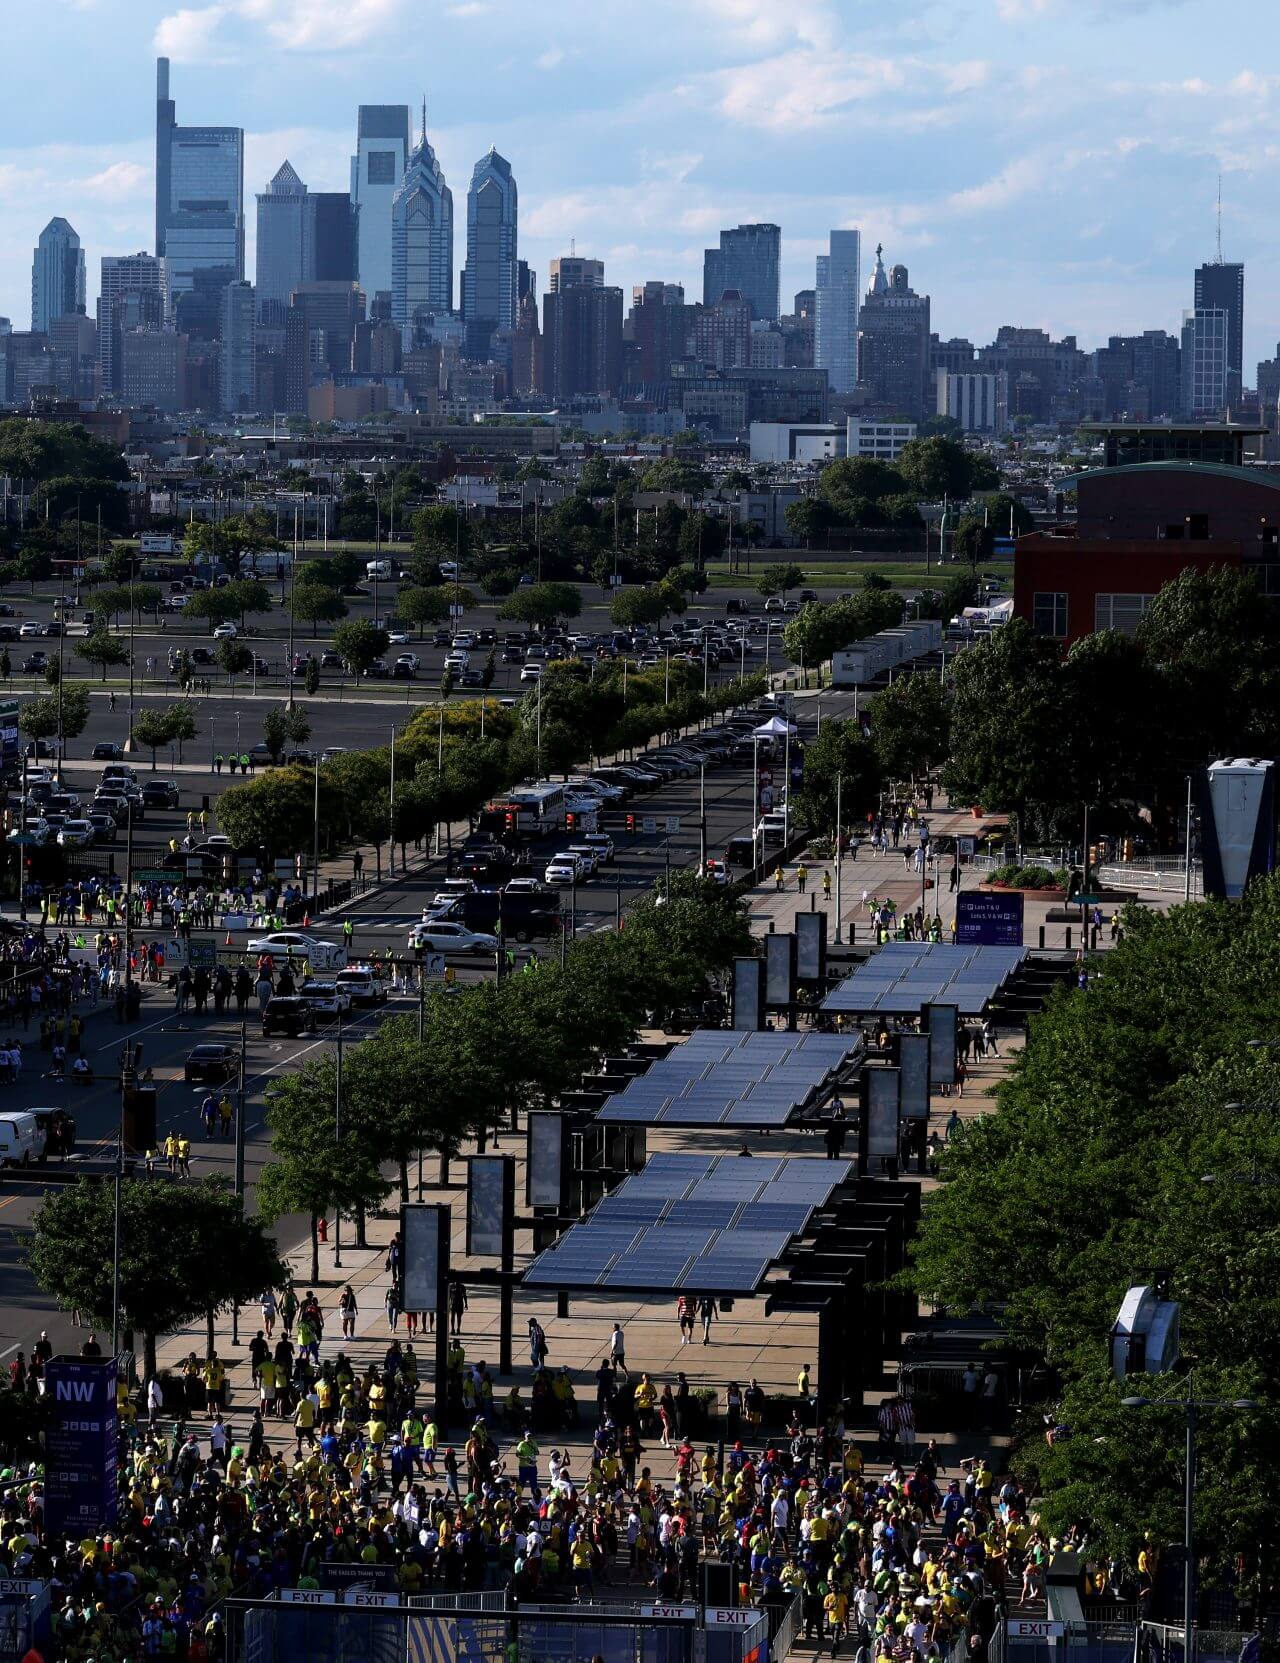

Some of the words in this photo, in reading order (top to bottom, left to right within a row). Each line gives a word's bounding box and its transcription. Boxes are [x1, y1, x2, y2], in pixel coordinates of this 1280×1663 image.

[56, 1380, 96, 1402] NW
[1, 1581, 31, 1593] EXIT
[293, 1593, 324, 1603] EXIT
[356, 1595, 387, 1606] EXIT
[652, 1608, 684, 1617] EXIT
[717, 1611, 749, 1623] EXIT
[1020, 1624, 1052, 1635] EXIT
